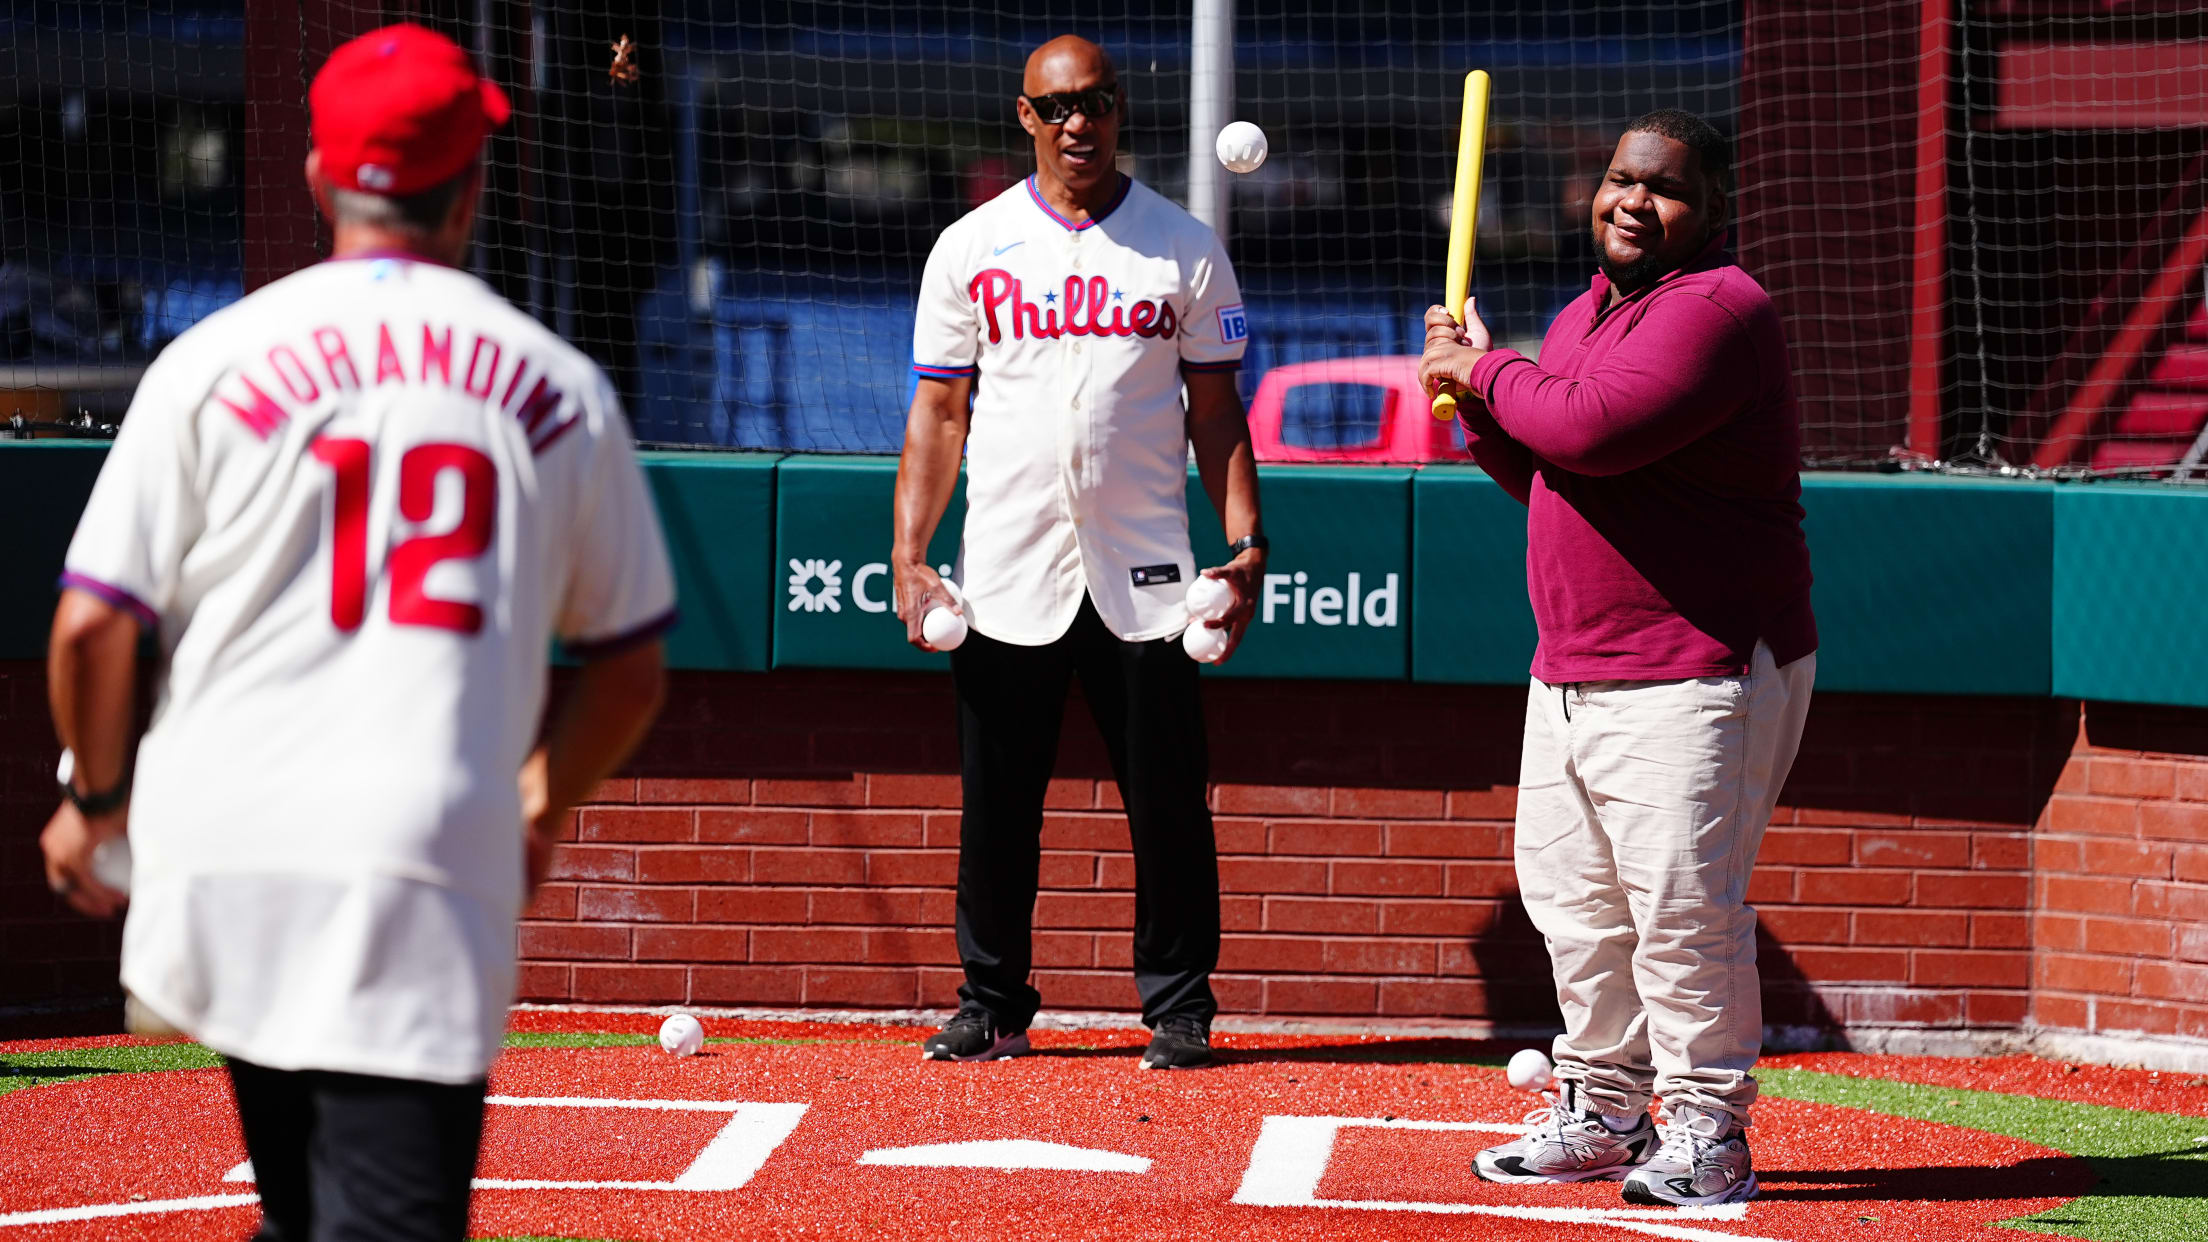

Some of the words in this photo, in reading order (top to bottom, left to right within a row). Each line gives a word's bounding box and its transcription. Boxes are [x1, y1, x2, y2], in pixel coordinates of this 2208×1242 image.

[969, 268, 1177, 344] Phillies
[215, 321, 581, 456] MORANDINI
[308, 433, 499, 635] 12
[1262, 570, 1399, 627] Field
[1572, 1145, 1597, 1162] N
